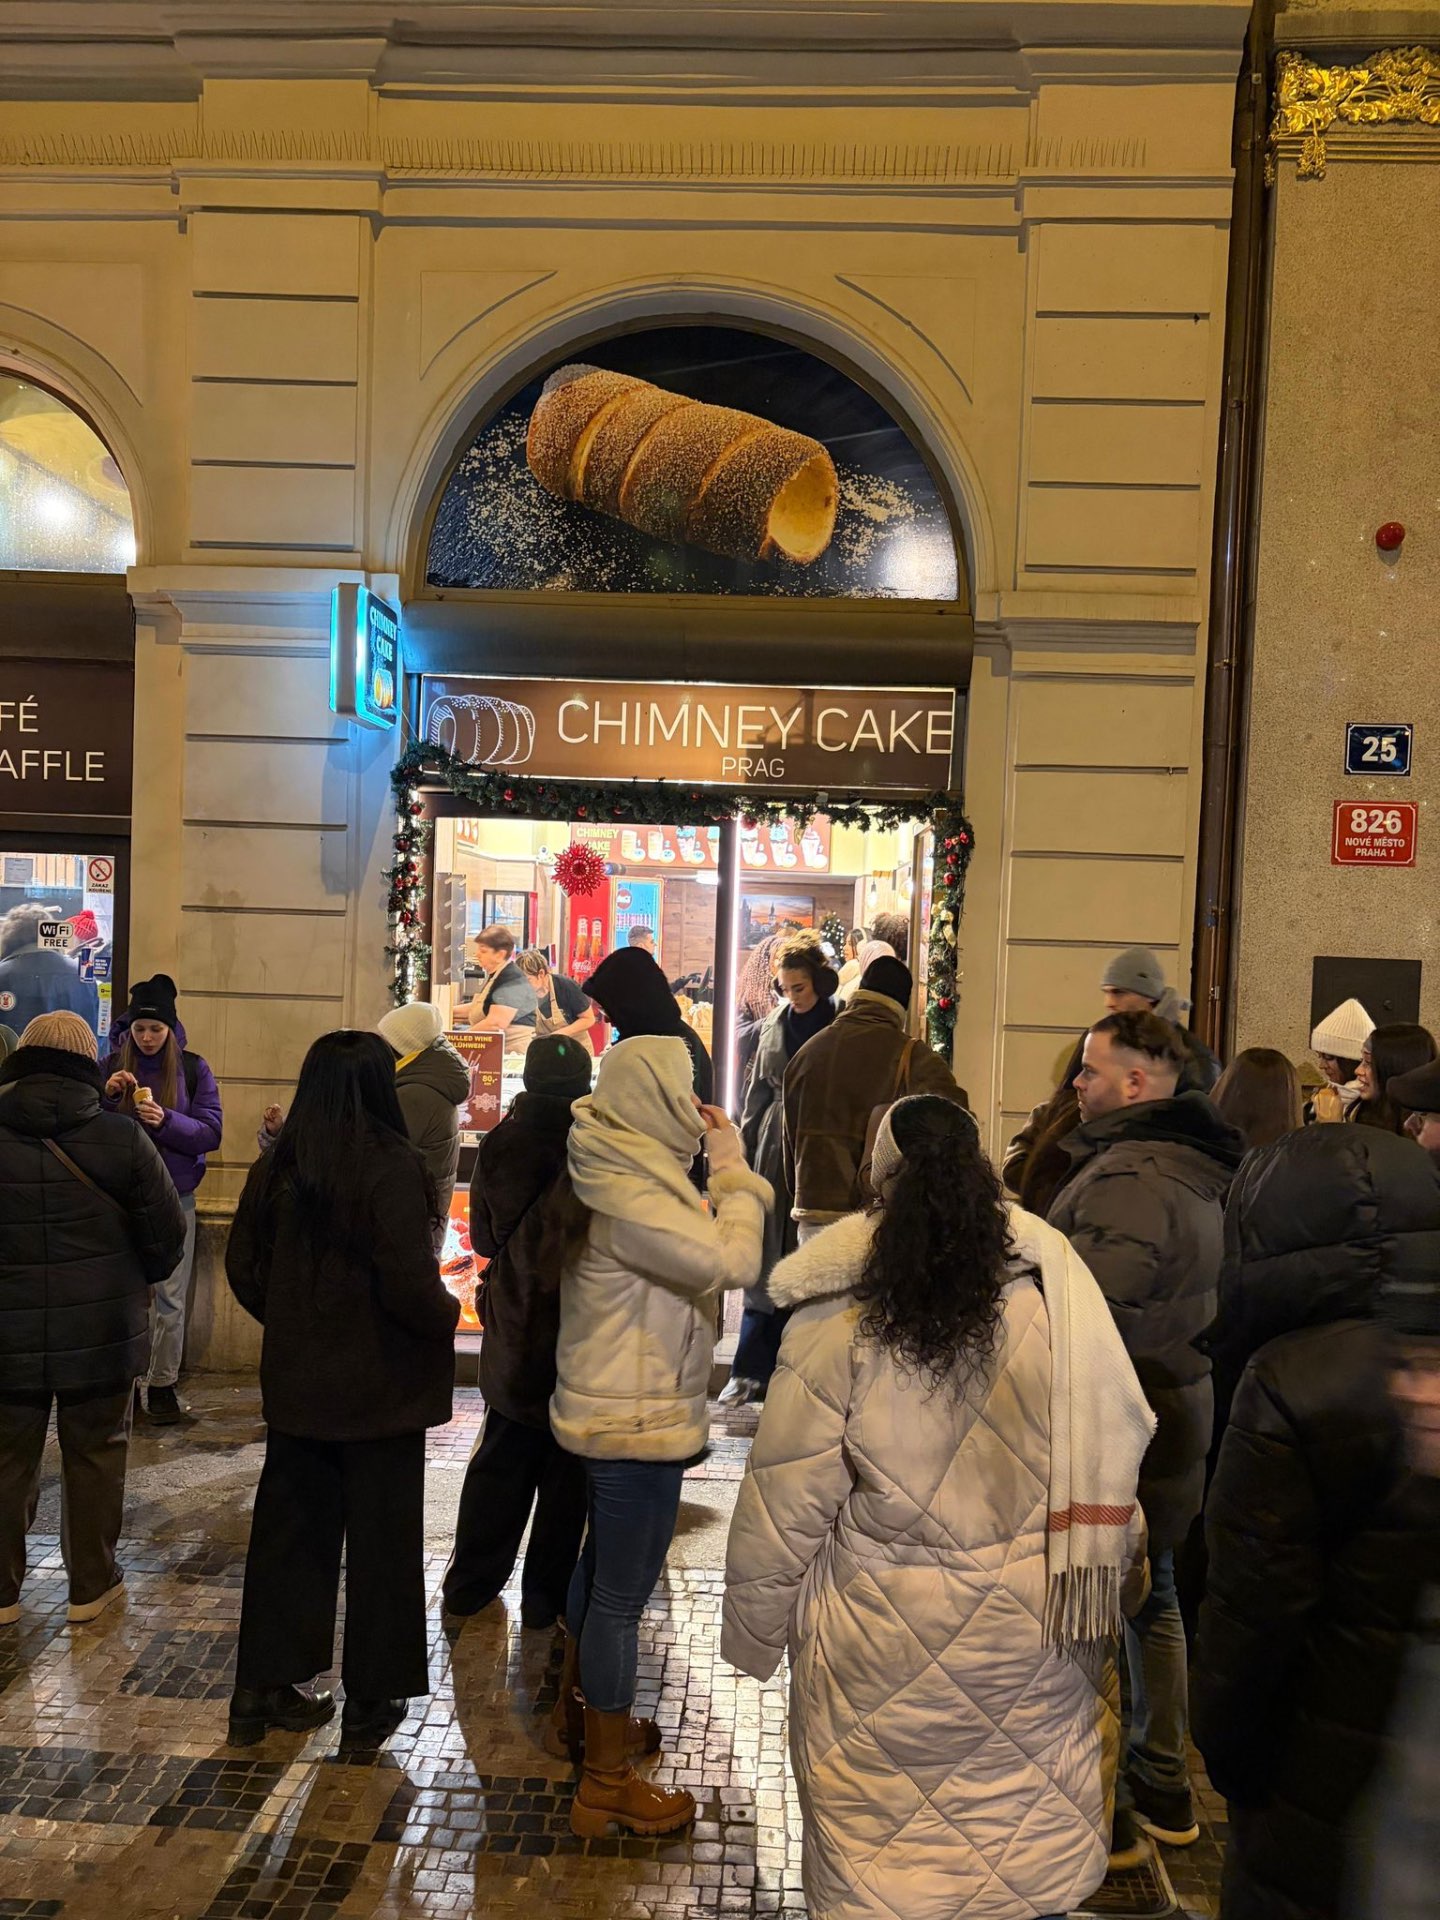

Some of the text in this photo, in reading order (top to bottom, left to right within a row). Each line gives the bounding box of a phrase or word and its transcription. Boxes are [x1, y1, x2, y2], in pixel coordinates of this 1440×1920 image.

[369, 606, 397, 641] CHIMNEY
[376, 635, 393, 662] CAKE
[558, 699, 953, 754] CHIMNEY CAKE
[1361, 736, 1397, 762] 25
[0, 749, 105, 782] AFFLE
[721, 756, 785, 778] PRAG
[576, 827, 619, 839] CHIMNEY
[1350, 808, 1402, 834] 826
[1345, 836, 1372, 847] NOVÉ
[1355, 848, 1395, 857] PRAHA 1
[43, 939, 68, 947] FREE
